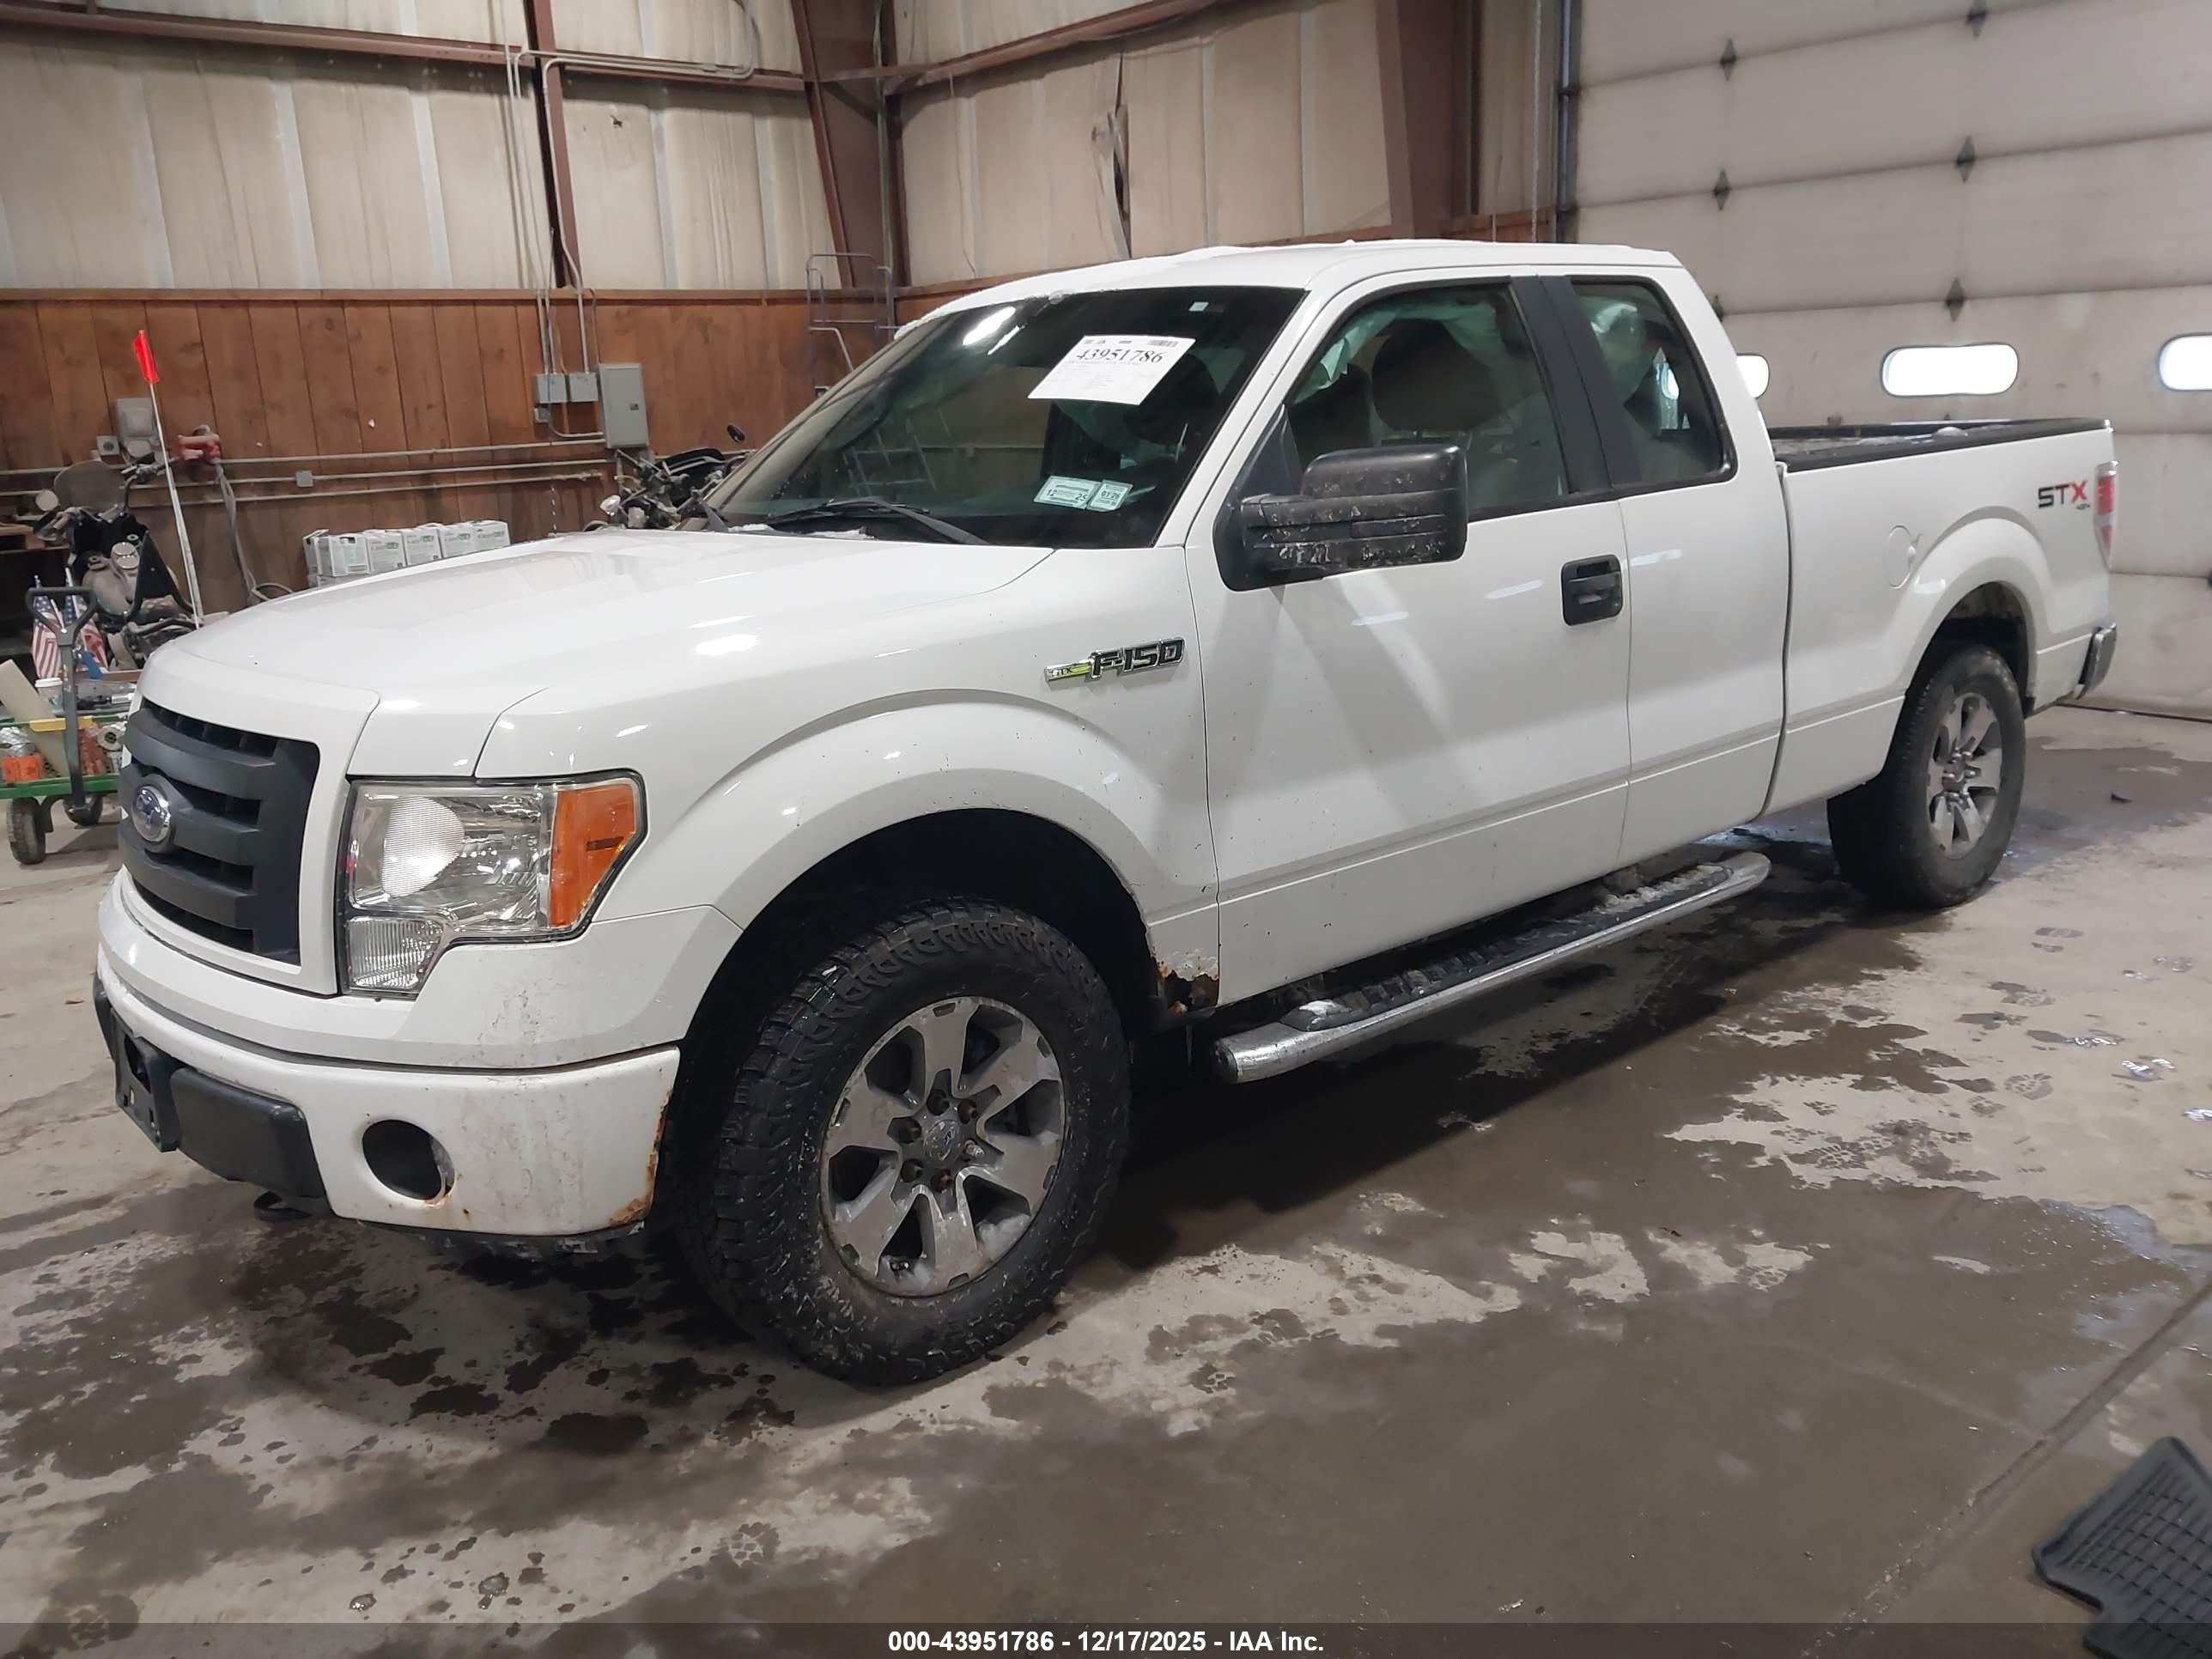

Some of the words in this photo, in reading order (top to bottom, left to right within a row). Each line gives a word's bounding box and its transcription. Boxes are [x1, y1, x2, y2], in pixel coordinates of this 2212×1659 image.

[1076, 348, 1168, 364] 43951786
[2038, 479, 2087, 509] STX
[1091, 636, 1186, 681] F-150
